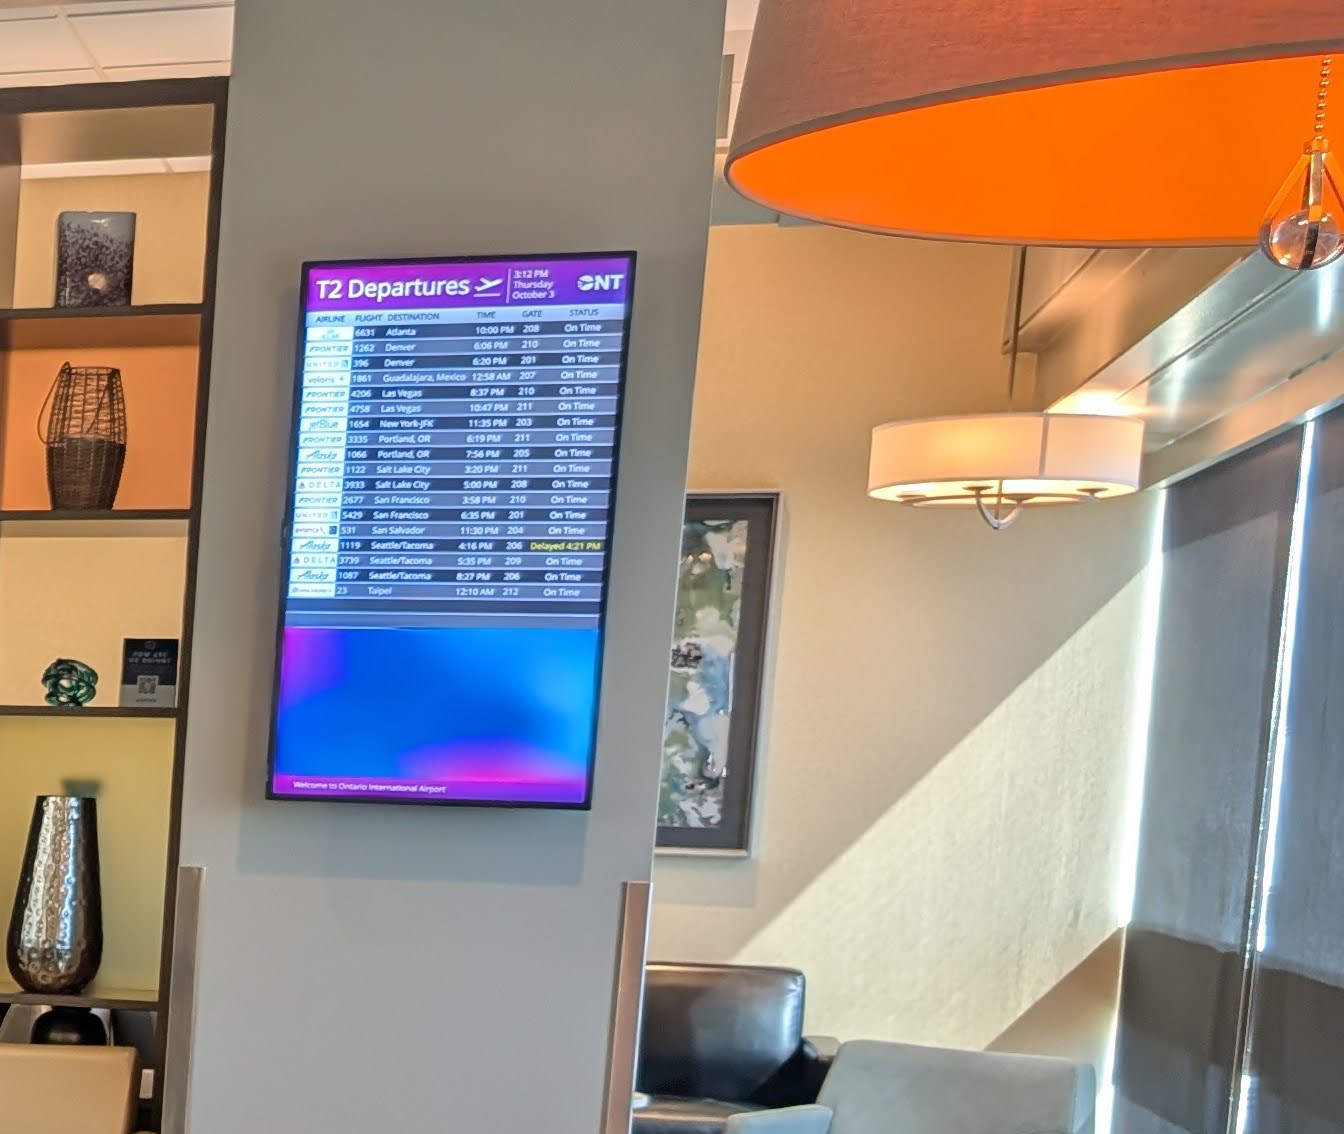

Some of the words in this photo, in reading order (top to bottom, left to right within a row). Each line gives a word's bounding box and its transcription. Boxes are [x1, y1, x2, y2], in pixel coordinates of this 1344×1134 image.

[513, 269, 531, 278] 3:12
[533, 269, 549, 278] PM
[512, 279, 554, 290] Thursday
[577, 274, 624, 291] ONT
[315, 279, 342, 299] T2
[348, 278, 470, 302] Departures
[511, 290, 547, 300] October
[548, 290, 554, 298] 3
[315, 315, 345, 323] AIRLINE
[355, 314, 383, 322] FLIGHT
[387, 312, 440, 321] DESTINATION
[476, 311, 496, 319] TIME
[521, 310, 542, 318] GATE
[568, 308, 599, 316] STATUS
[386, 327, 416, 336] Atlanta
[475, 325, 499, 334] 10:00
[500, 325, 514, 333] PM
[564, 323, 578, 332] On
[578, 323, 602, 331] Time
[384, 343, 416, 351] Denver
[493, 341, 508, 349] PM
[521, 340, 539, 348] 210
[563, 339, 576, 347] On
[577, 338, 601, 347] Time
[383, 358, 415, 366] Denver
[472, 357, 491, 365] 6:20
[492, 356, 507, 365] PM
[520, 356, 536, 364] 201
[562, 355, 575, 363] On
[576, 354, 599, 363] Time
[436, 372, 467, 381] Mexico
[496, 372, 511, 380] AM
[519, 371, 536, 379] 207
[561, 371, 574, 379] On
[574, 370, 598, 378] Time
[381, 389, 396, 397] Las
[397, 389, 422, 399] Vegas
[490, 388, 505, 396] PM
[517, 387, 535, 395] 210
[559, 386, 572, 394] On
[573, 386, 597, 394] Time
[396, 404, 421, 414] Vegas
[494, 403, 508, 411] PM
[516, 403, 532, 411] 211
[558, 402, 571, 410] On
[572, 402, 596, 410] Time
[379, 420, 398, 428] New
[493, 419, 507, 427] PM
[557, 418, 570, 426] On
[571, 417, 594, 426] Time
[417, 435, 431, 443] OR
[486, 434, 501, 442] PM
[514, 434, 530, 442] 211
[556, 433, 569, 441] On
[569, 433, 593, 441] Time
[416, 450, 430, 458] OR
[485, 450, 500, 458] PM
[554, 449, 567, 457] On
[568, 449, 592, 457] Time
[345, 466, 366, 474] 1122
[375, 466, 392, 474] Salt
[414, 465, 431, 475] City
[484, 465, 499, 473] PM
[511, 465, 527, 473] 211
[553, 465, 566, 473] On
[567, 465, 590, 473] Time
[374, 481, 391, 489] Salt
[392, 481, 412, 489] Lake
[412, 481, 429, 490] City
[482, 481, 497, 489] PM
[552, 480, 565, 488] On
[566, 480, 589, 488] Time
[373, 496, 390, 504] San
[391, 496, 430, 504] Francisco
[481, 496, 496, 504] PM
[509, 496, 526, 504] 210
[551, 496, 564, 504] On
[564, 496, 588, 504] Time
[390, 511, 429, 519] Francisco
[480, 512, 495, 520] PM
[508, 511, 524, 519] 201
[563, 511, 587, 519] Time
[460, 527, 483, 535] 11:30
[484, 527, 499, 535] PM
[506, 527, 524, 535] 204
[548, 527, 561, 535] On
[562, 527, 585, 535] Time
[529, 542, 564, 551] Delayed
[585, 542, 601, 550] PM
[477, 558, 491, 566] PM
[546, 558, 559, 566] On
[559, 558, 583, 566] Time
[475, 573, 490, 581] PM
[558, 574, 581, 582] Time
[336, 587, 347, 595] 23
[366, 587, 392, 597] Taipei
[479, 589, 494, 597] AM
[543, 589, 556, 597] On
[557, 589, 580, 597] Time
[293, 781, 327, 789] Welcome
[338, 782, 367, 791] Ontario
[368, 783, 418, 792] International
[418, 785, 446, 794] Airport
